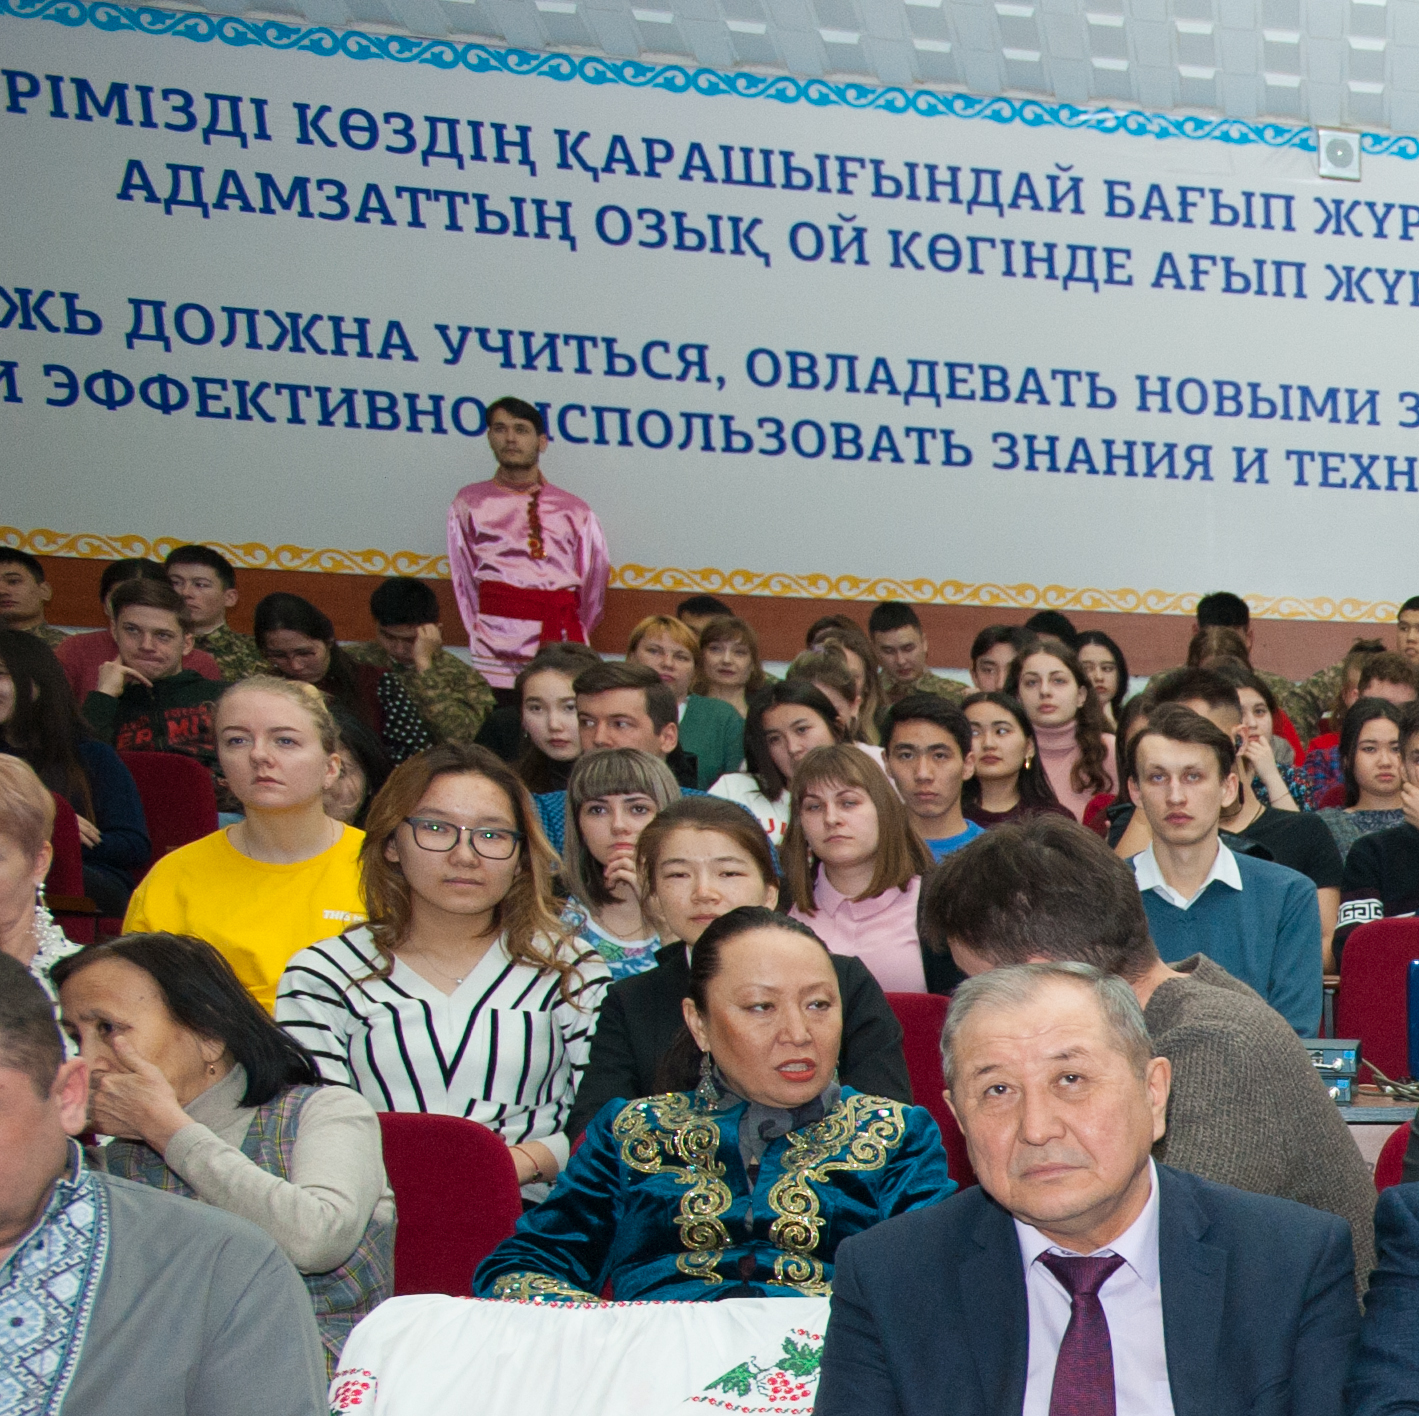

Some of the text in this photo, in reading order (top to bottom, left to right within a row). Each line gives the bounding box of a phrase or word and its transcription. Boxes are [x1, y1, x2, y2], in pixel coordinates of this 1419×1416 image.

[1, 69, 273, 150] РІМІЗДІ
[293, 103, 537, 177] КӨЗДІҢ
[555, 130, 1085, 218] ҚАРАШЫҒЫНДАЙ
[1105, 181, 1296, 232] БАҒЫП
[117, 160, 577, 252] АДАМЗАТТЫҢ
[596, 206, 771, 268] ОЗЫҚ
[790, 214, 870, 266] ОЙ
[889, 230, 1133, 293] КӨГІНДЕ
[1152, 253, 1307, 299] АҒЫП
[43, 364, 488, 438] ЭФФЕКТИВНО
[993, 433, 1214, 481] ЗНАНИЯ
[1234, 448, 1269, 484] И
[125, 298, 419, 363] ДОЛЖНА
[435, 325, 726, 391] УЧИТЬСЯ,
[747, 349, 1117, 410] ОВЛАДЕВАТЬ
[1137, 376, 1380, 426] НОВЫМИ
